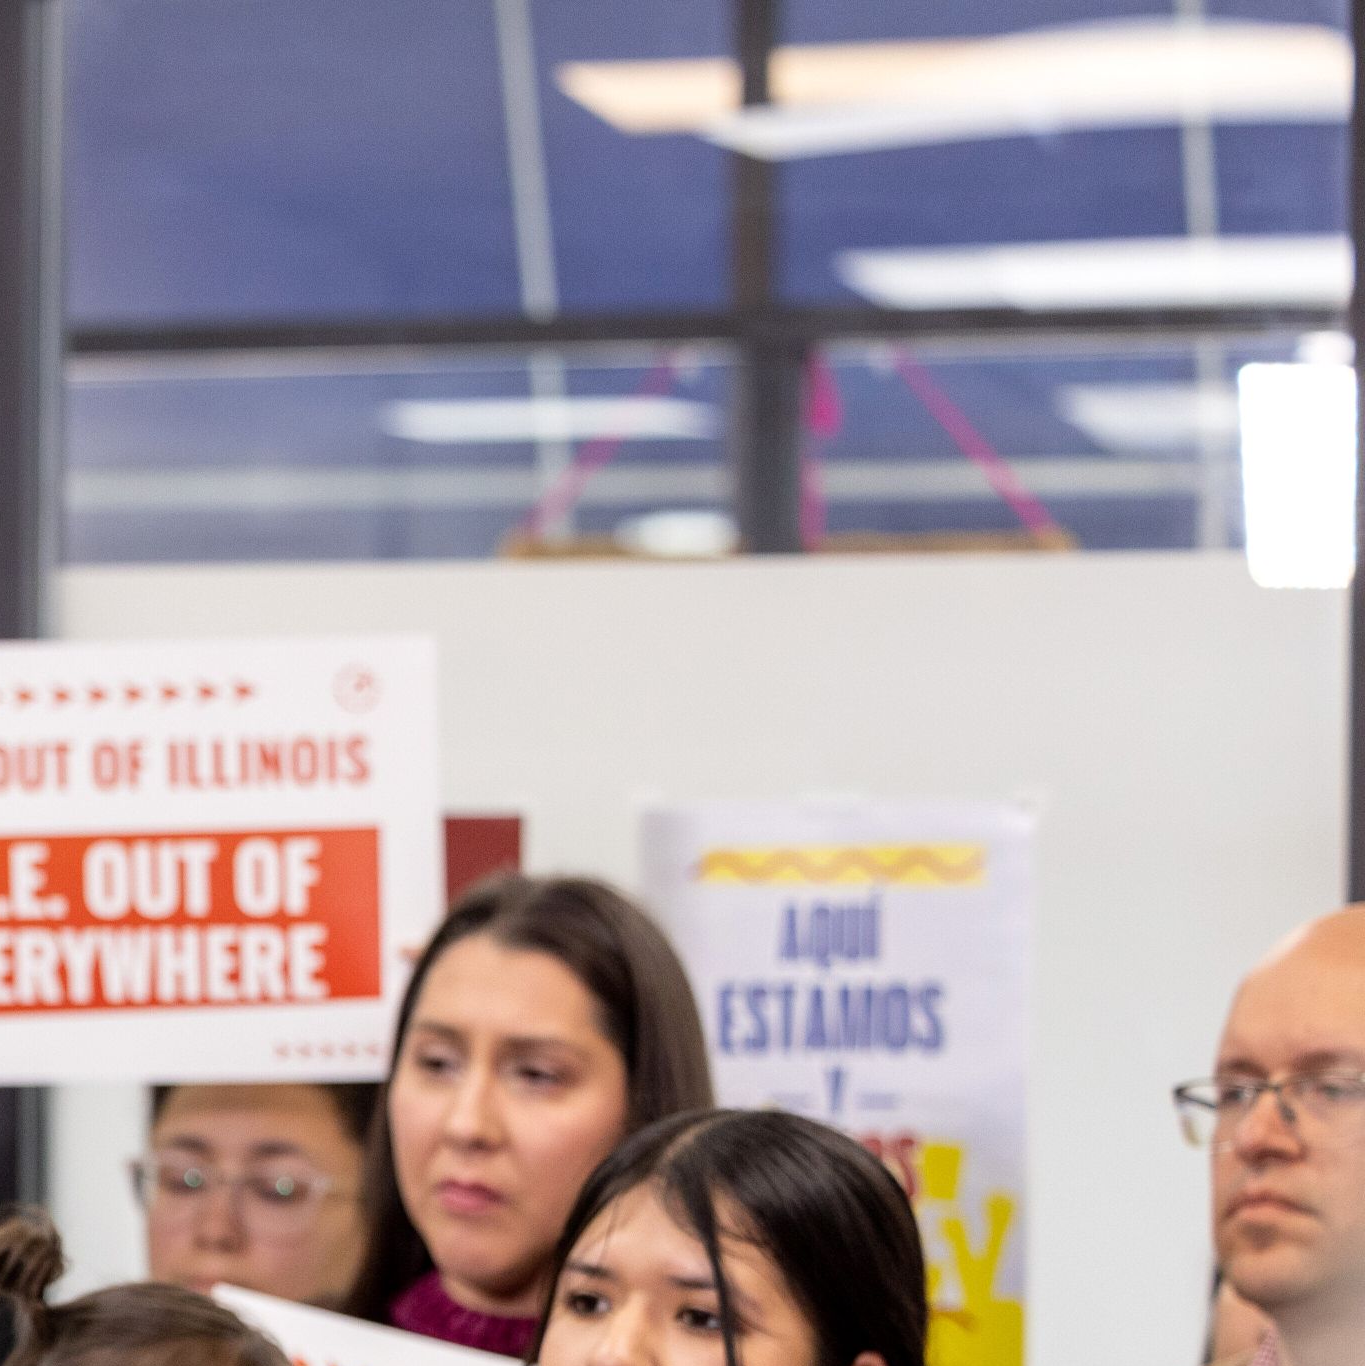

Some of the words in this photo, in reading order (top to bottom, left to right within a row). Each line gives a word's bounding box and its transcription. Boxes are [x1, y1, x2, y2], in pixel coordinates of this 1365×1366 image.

[91, 738, 151, 791] OF
[167, 734, 372, 790] ILLINOIS
[82, 837, 220, 919] OUT
[232, 835, 323, 915] OF
[716, 979, 947, 1057] ESTAMOS
